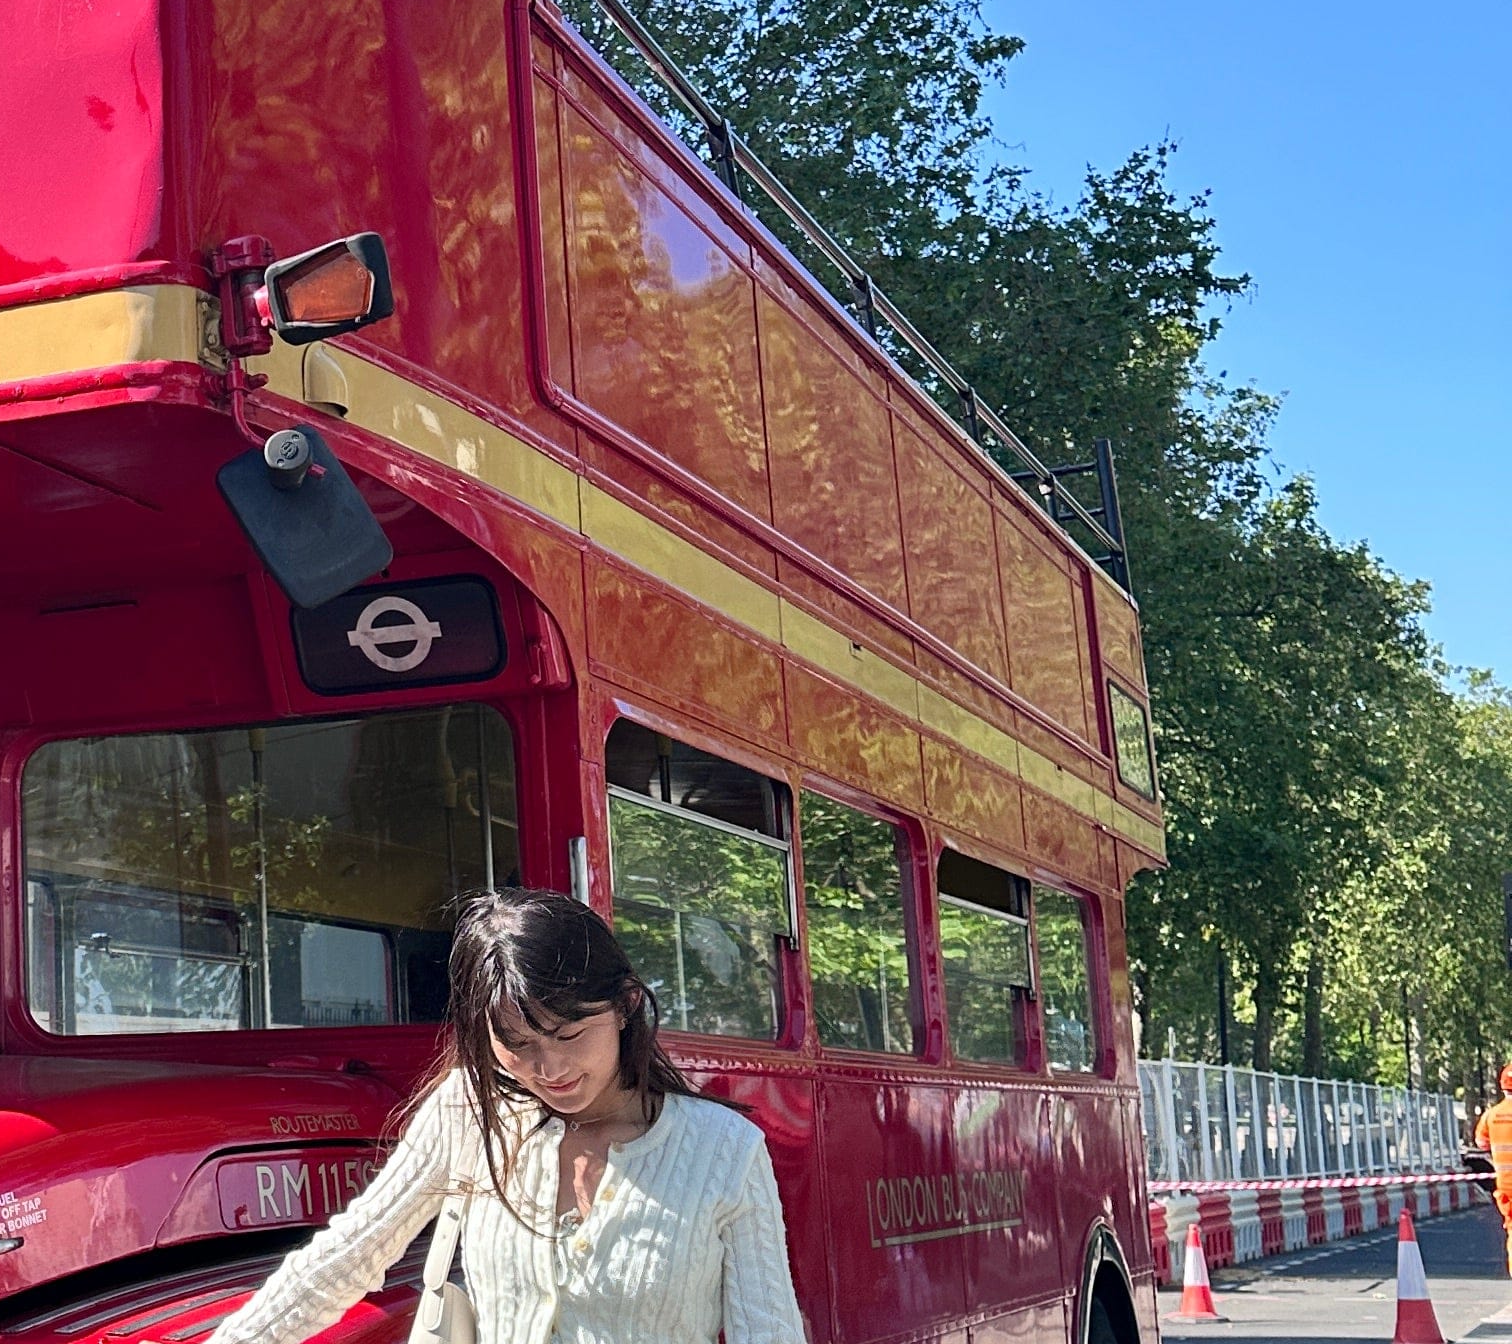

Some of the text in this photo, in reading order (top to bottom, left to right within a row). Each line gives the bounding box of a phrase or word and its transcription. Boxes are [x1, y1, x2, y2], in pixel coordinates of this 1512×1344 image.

[269, 1113, 361, 1134] ROUTEMASTER
[256, 1163, 313, 1218] RM
[1, 1205, 21, 1220] OFF
[22, 1197, 41, 1212] TAP
[866, 1170, 1028, 1247] LONDON BUS COMPANY
[8, 1209, 48, 1232] BONNET
